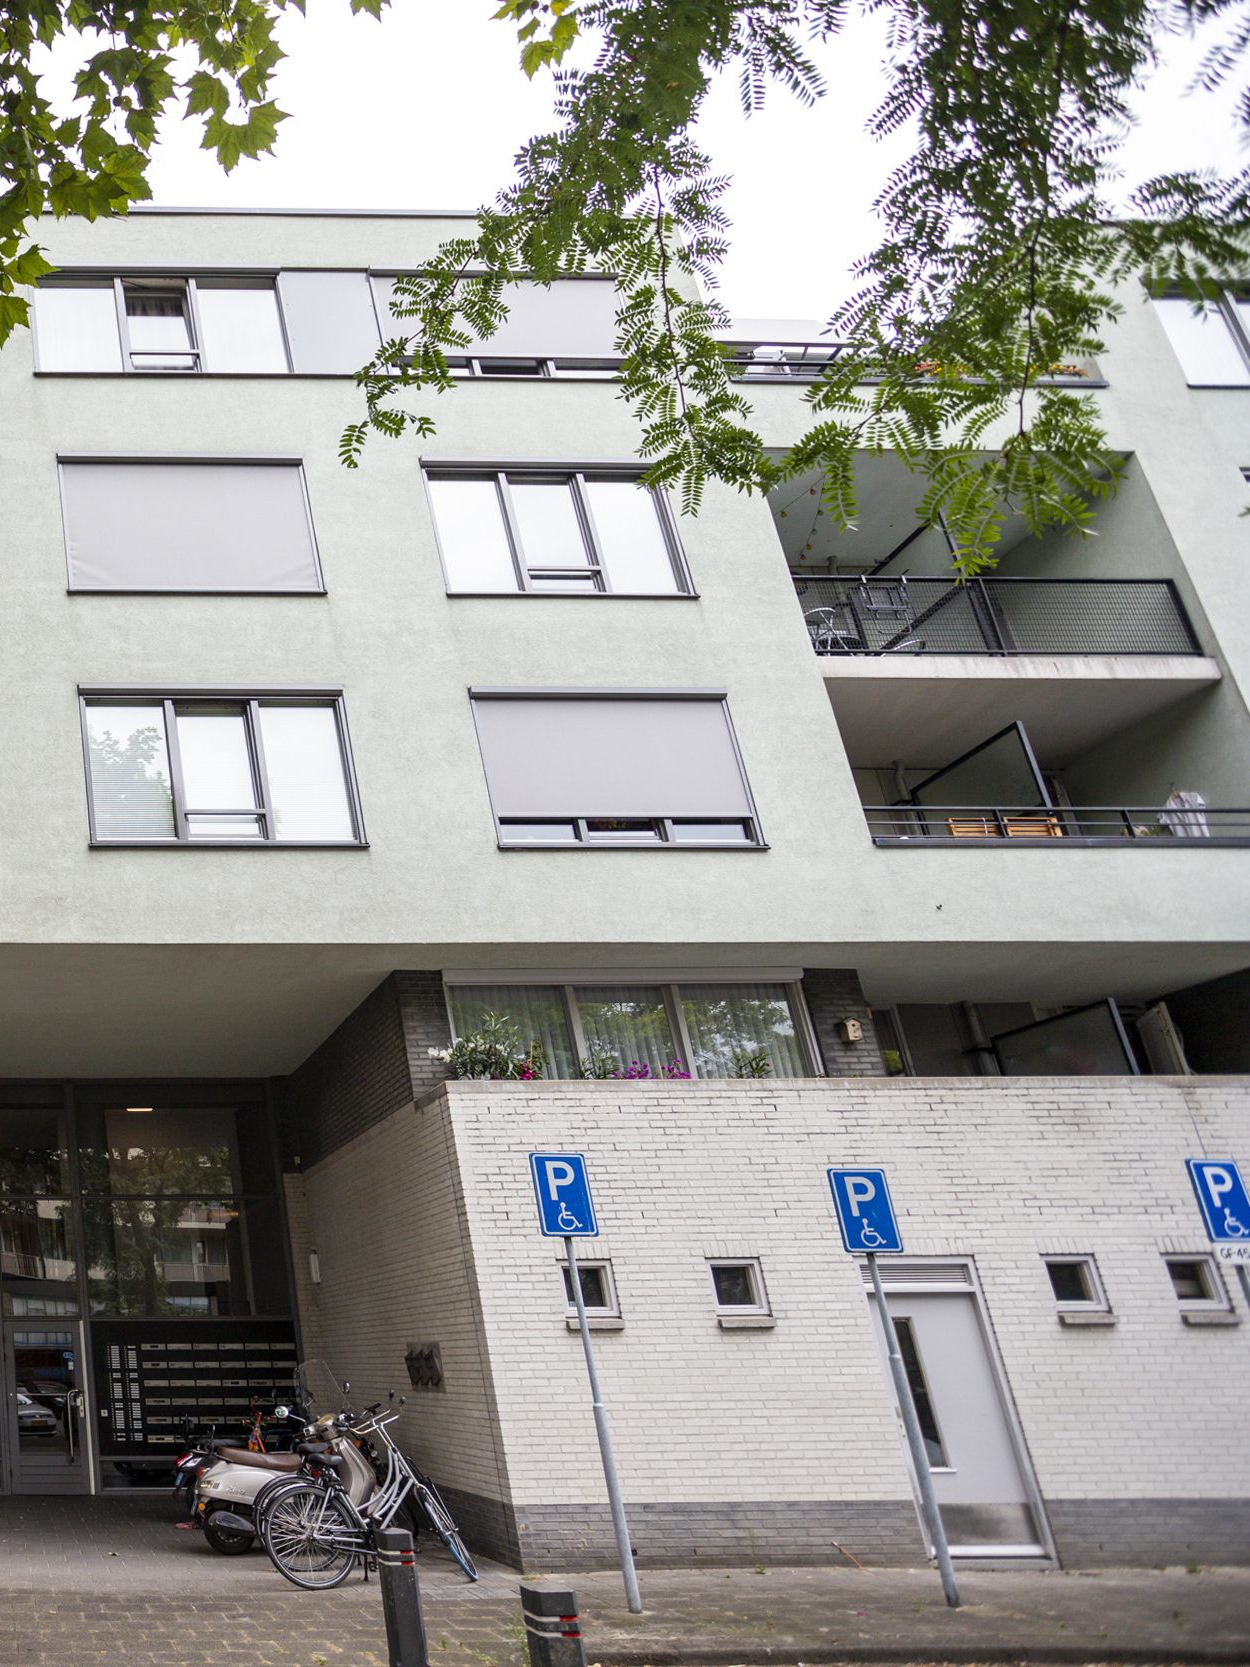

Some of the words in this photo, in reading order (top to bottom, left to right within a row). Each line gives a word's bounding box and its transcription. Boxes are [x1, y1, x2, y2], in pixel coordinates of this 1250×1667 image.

[545, 1161, 575, 1200] P
[844, 1177, 876, 1217] P
[1202, 1166, 1233, 1207] P
